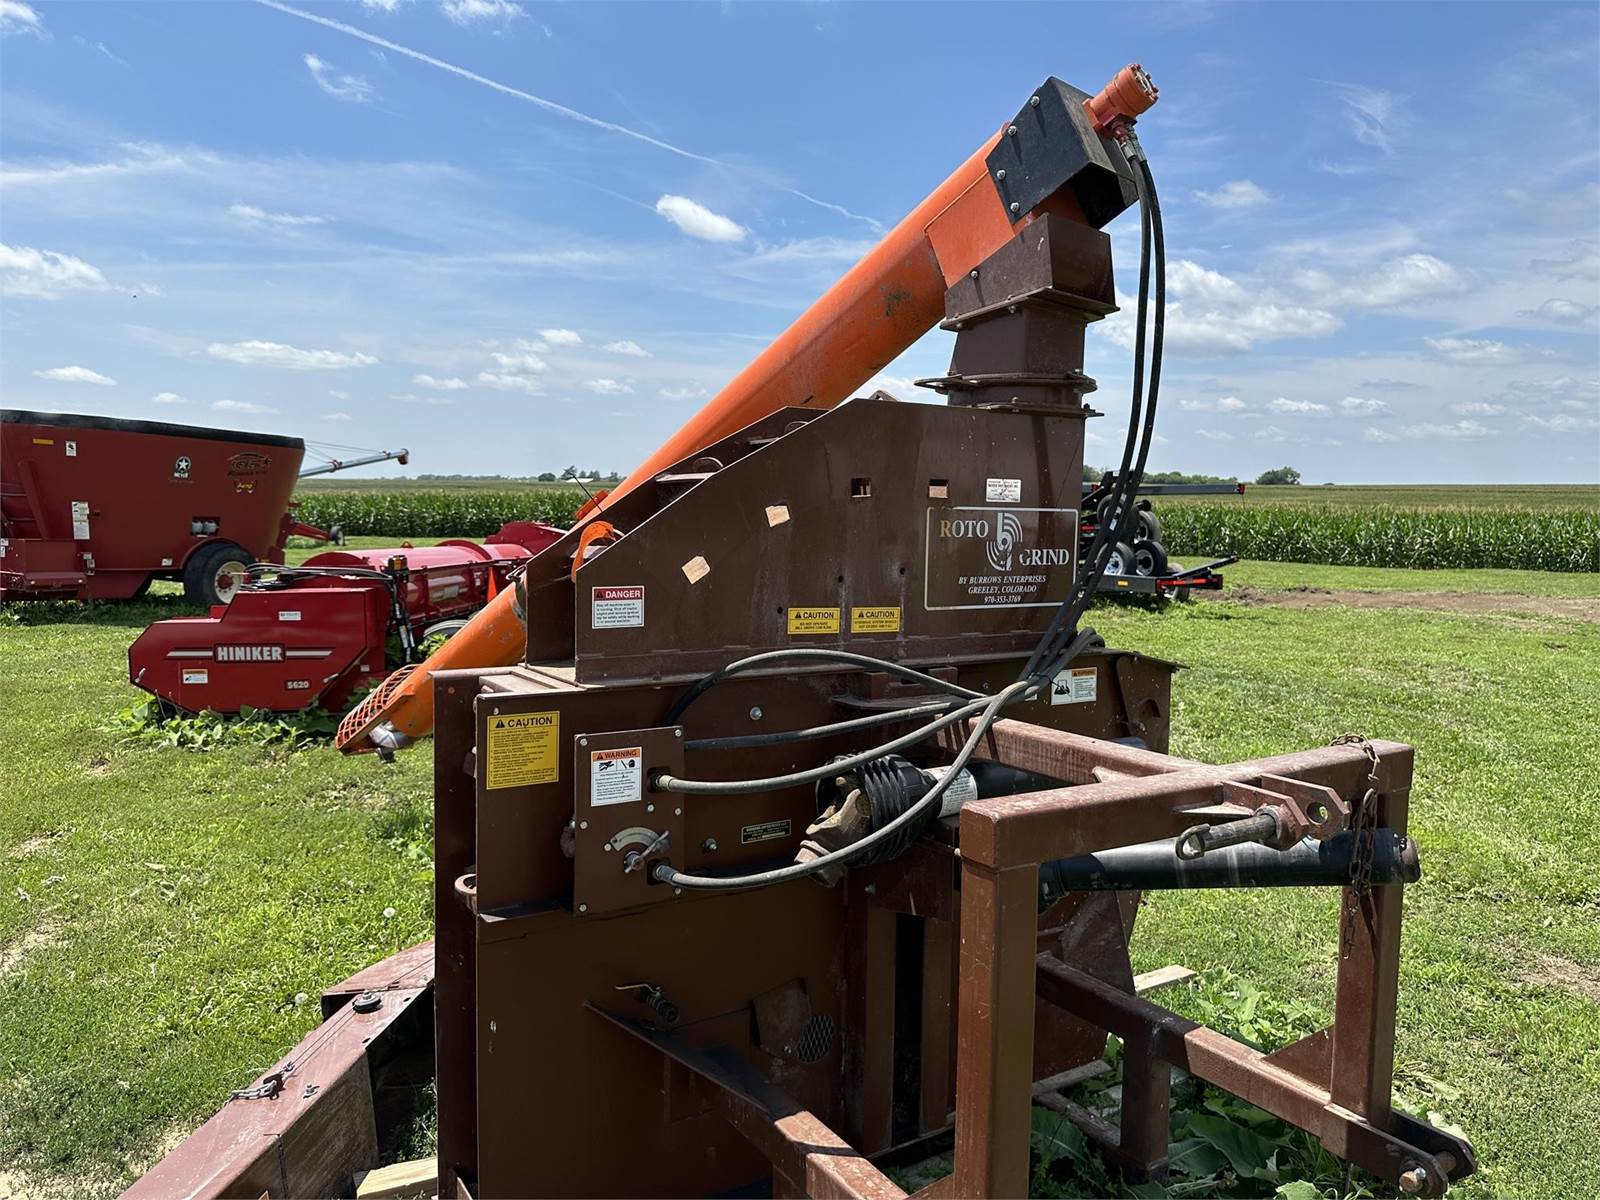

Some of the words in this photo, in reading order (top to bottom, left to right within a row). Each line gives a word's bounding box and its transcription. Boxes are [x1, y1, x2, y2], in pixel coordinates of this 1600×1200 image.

[940, 520, 989, 538] ROTO
[1019, 549, 1070, 565] GRIND
[958, 576, 968, 584] BY
[969, 575, 1002, 584] BURROWS
[1003, 575, 1047, 584] ENTERPRISES
[968, 585, 1001, 594] GREELEY,
[1001, 585, 1037, 593] COLORADO
[605, 590, 641, 599] DANGER
[803, 611, 834, 619] CAUTION
[865, 610, 895, 619] CAUTION
[217, 646, 283, 661] HINIKER
[287, 681, 310, 689] 5620
[507, 716, 553, 728] CAUTION
[604, 750, 637, 759] WARNING
